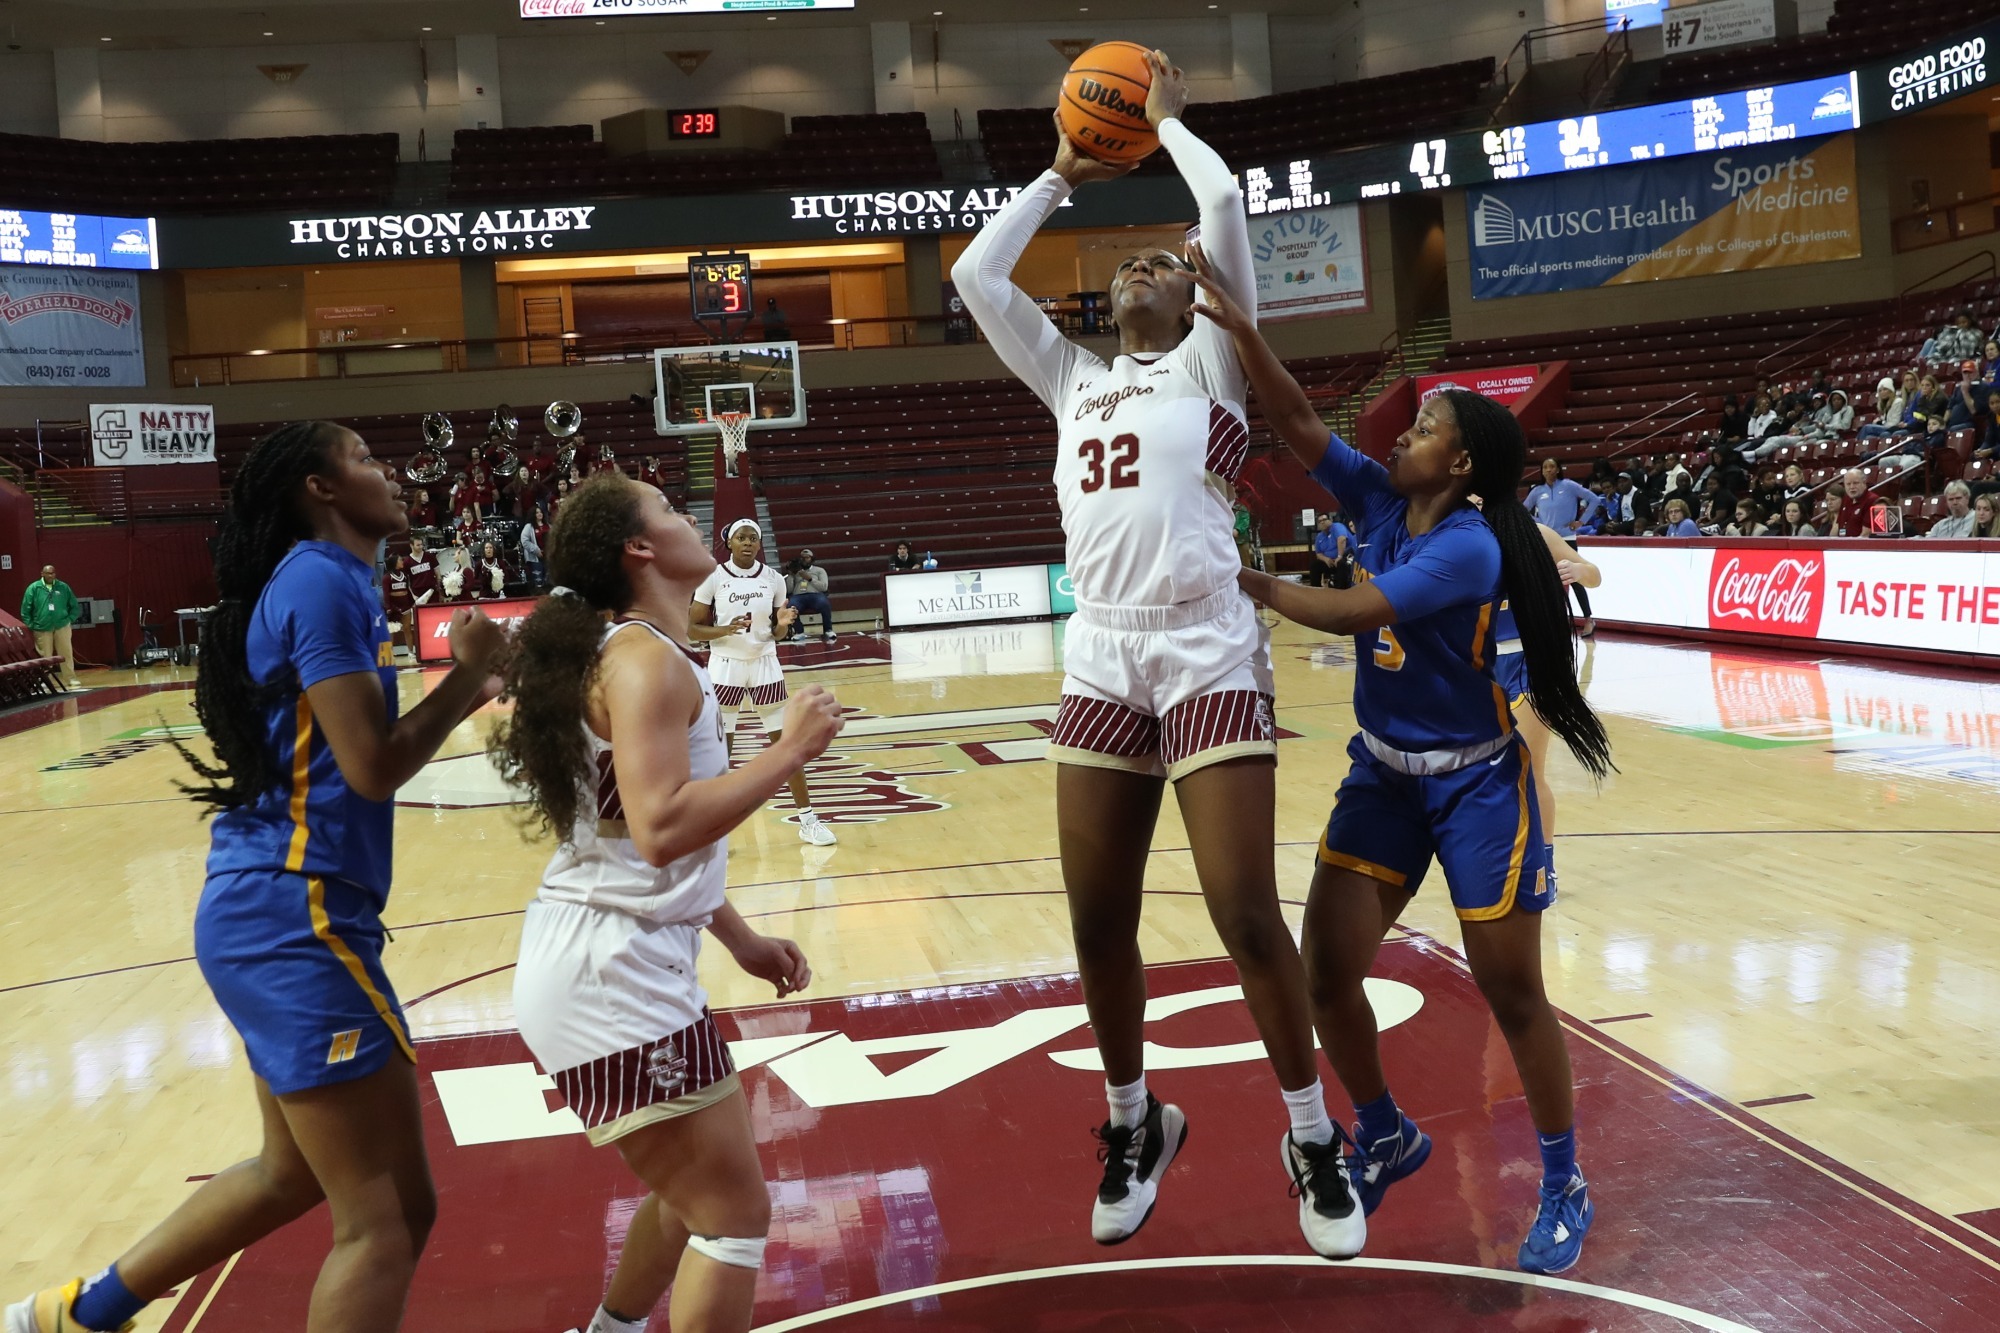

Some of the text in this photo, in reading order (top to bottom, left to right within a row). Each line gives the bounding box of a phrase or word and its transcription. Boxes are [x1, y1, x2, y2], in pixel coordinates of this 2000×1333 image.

[522, 0, 585, 15] CocaCola
[1666, 18, 1701, 48] #7
[1703, 25, 1714, 33] for
[1717, 18, 1752, 30] Veterans
[1719, 29, 1742, 39] South
[1889, 37, 1986, 88] GOOD FOOD
[1891, 63, 1986, 111] CATERING
[1558, 115, 1600, 156] 34
[1410, 139, 1447, 177] 47
[1565, 155, 1595, 169] FOULS
[1361, 183, 1389, 198] FOULS
[1711, 156, 1815, 197] Sports
[790, 189, 954, 219] HUTSON
[1736, 182, 1849, 215] Medicine
[289, 206, 596, 243] HUTSON ALLEY
[1517, 195, 1697, 242] MUSC Health
[1254, 212, 1342, 262] UPTOWN
[1277, 240, 1318, 253] HOSPITALITY
[1286, 250, 1309, 260] GROUP
[1478, 228, 1851, 280] The official sports medicine provider for the College of Charleston.
[63, 275, 84, 286] The
[7, 296, 119, 322] OVERHEAD DOOR
[723, 282, 739, 311] 3
[0, 346, 133, 357] verhead Door Company of Charleston
[26, 365, 54, 380] (843)
[56, 366, 76, 378] 767
[84, 366, 111, 378] 0028
[1477, 380, 1506, 389] LOCALLY
[1075, 385, 1155, 422] Cougars
[140, 411, 210, 432] NATTY
[141, 432, 213, 453] HEAVY
[1078, 432, 1140, 495] 32
[729, 591, 763, 606] Cougars
[1713, 556, 1821, 624] Coca-Cola
[1837, 580, 1999, 625] TASTE THE
[326, 1028, 362, 1065] H
